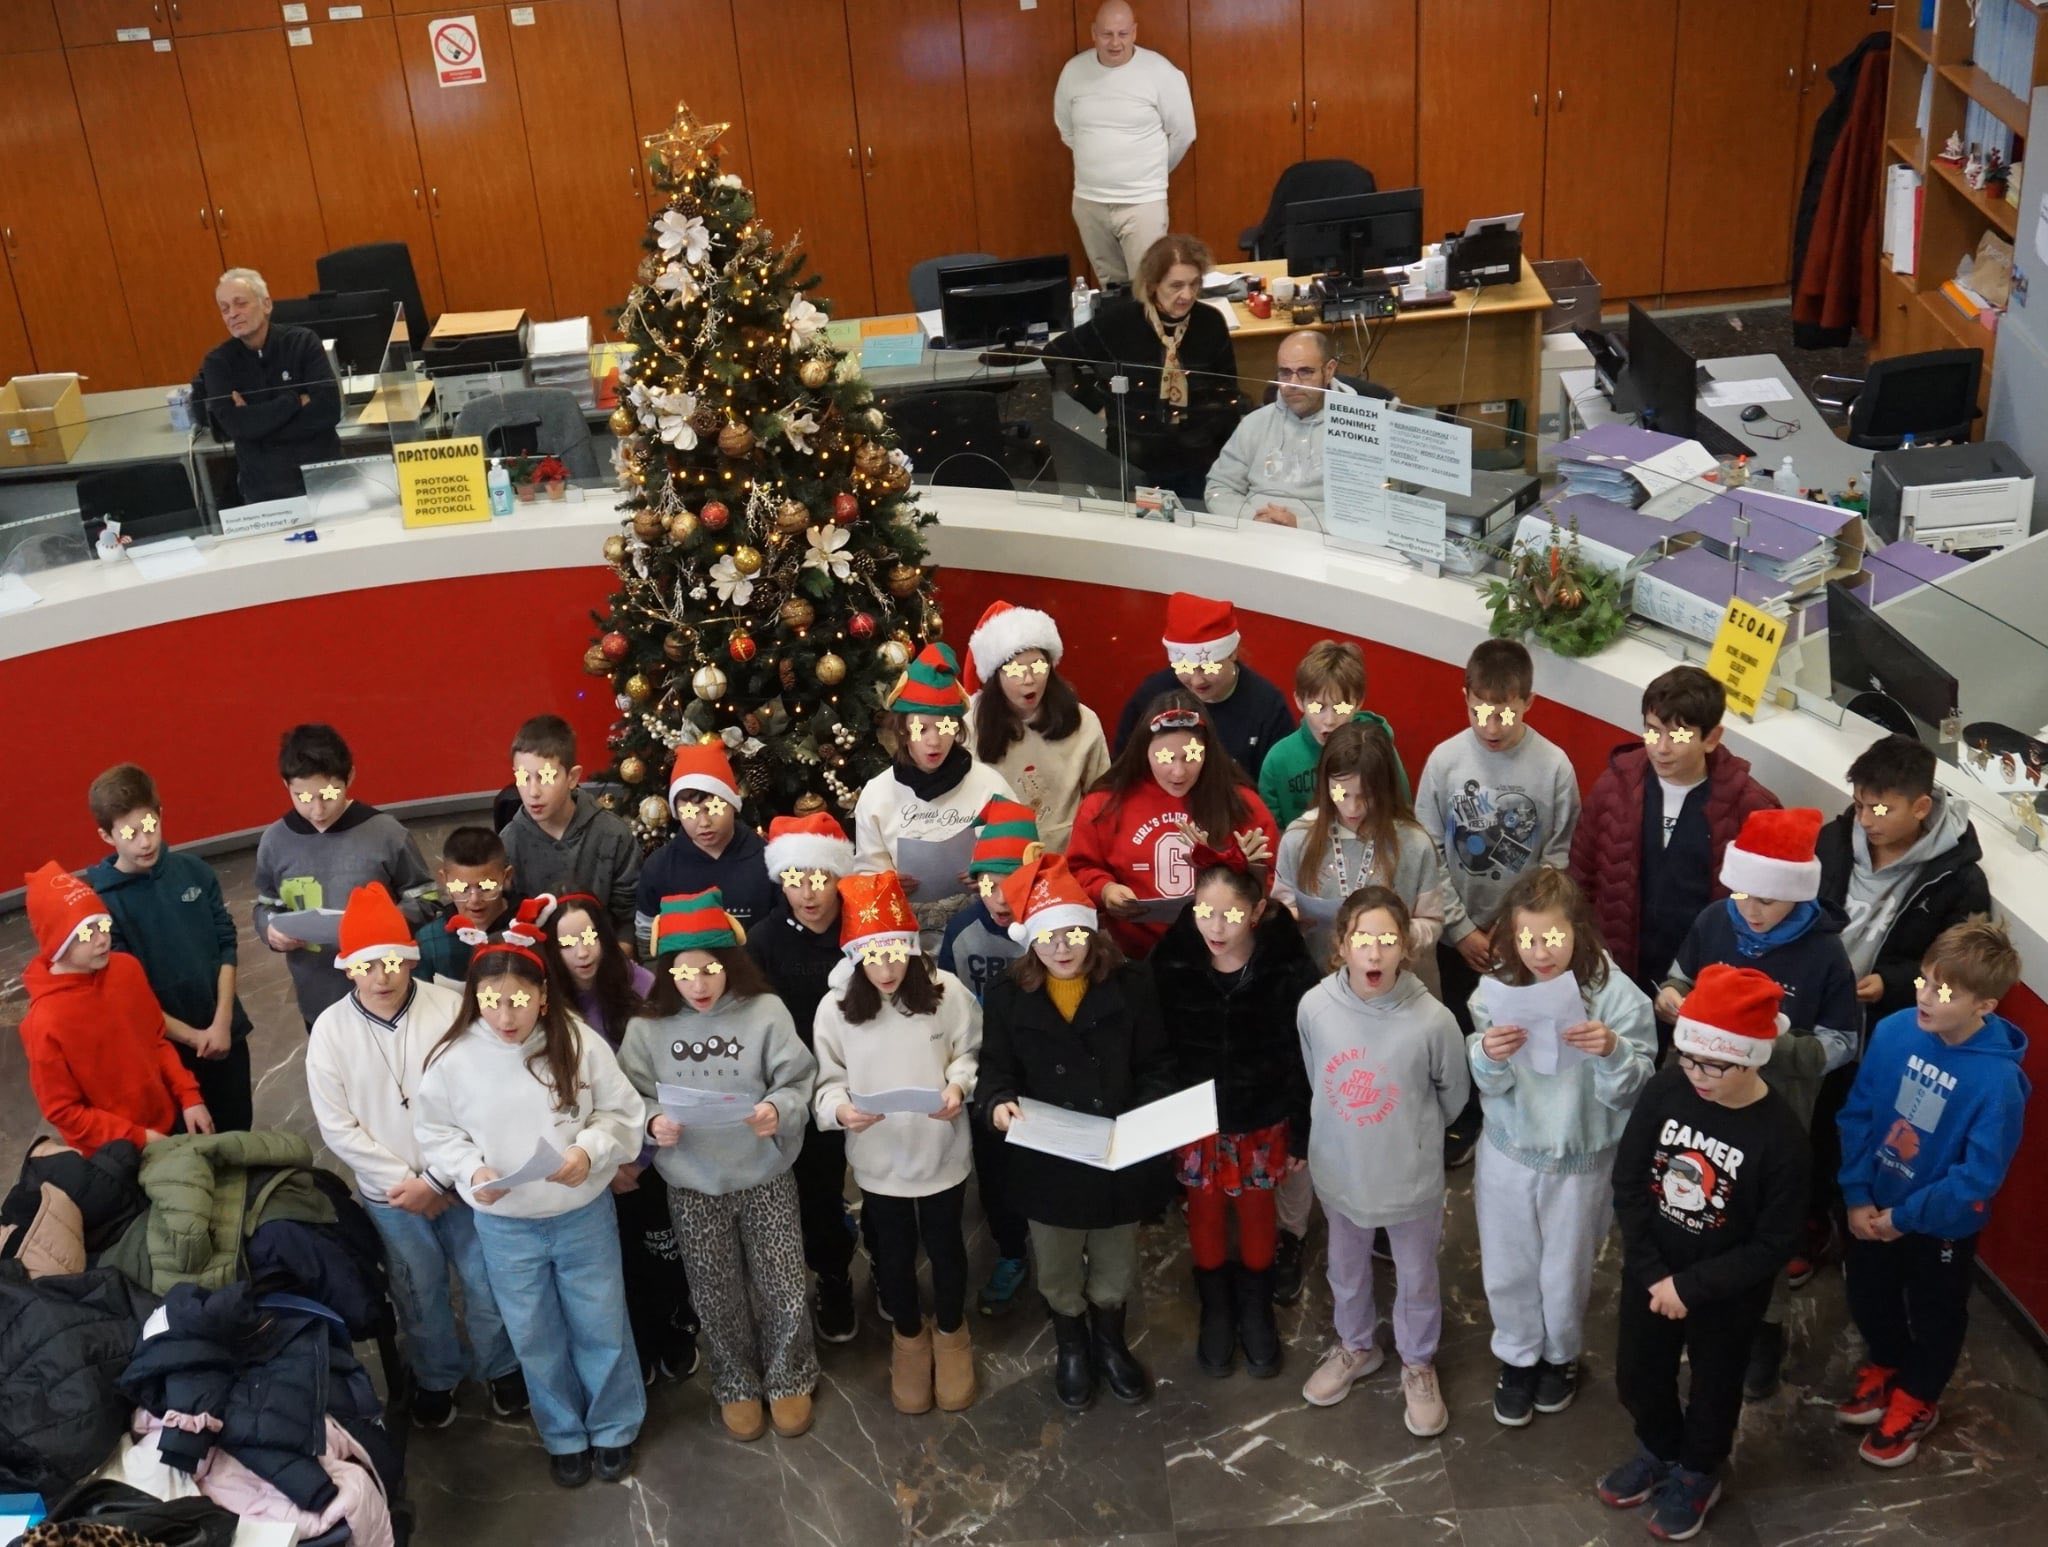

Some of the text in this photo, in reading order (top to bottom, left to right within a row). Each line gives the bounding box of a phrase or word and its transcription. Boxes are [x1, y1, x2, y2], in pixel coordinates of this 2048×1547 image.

[1329, 403, 1378, 419] ΒΕΒΑΙΩΣΗ
[1330, 416, 1377, 432] ΜΟΝΙΜΗΣ
[1327, 428, 1380, 446] ΚΑΤΟΙΚΙΑΣ
[398, 443, 479, 463] ΠΡΩΤΟΚΟΛΛΟ
[414, 475, 469, 486] PROTOKOL
[416, 484, 470, 496] PROTOKOL
[415, 503, 476, 515] PROTOKOLL
[1728, 607, 1776, 644] ΕΣΟΔΑ
[900, 804, 939, 829] Genius
[1132, 817, 1160, 845] GIRL'S
[1155, 832, 1195, 899] G
[1325, 1048, 1359, 1074] WEAR
[676, 1068, 740, 1078] VIBES
[1660, 1118, 1745, 1180] GAMER
[1686, 1214, 1705, 1231] ON
